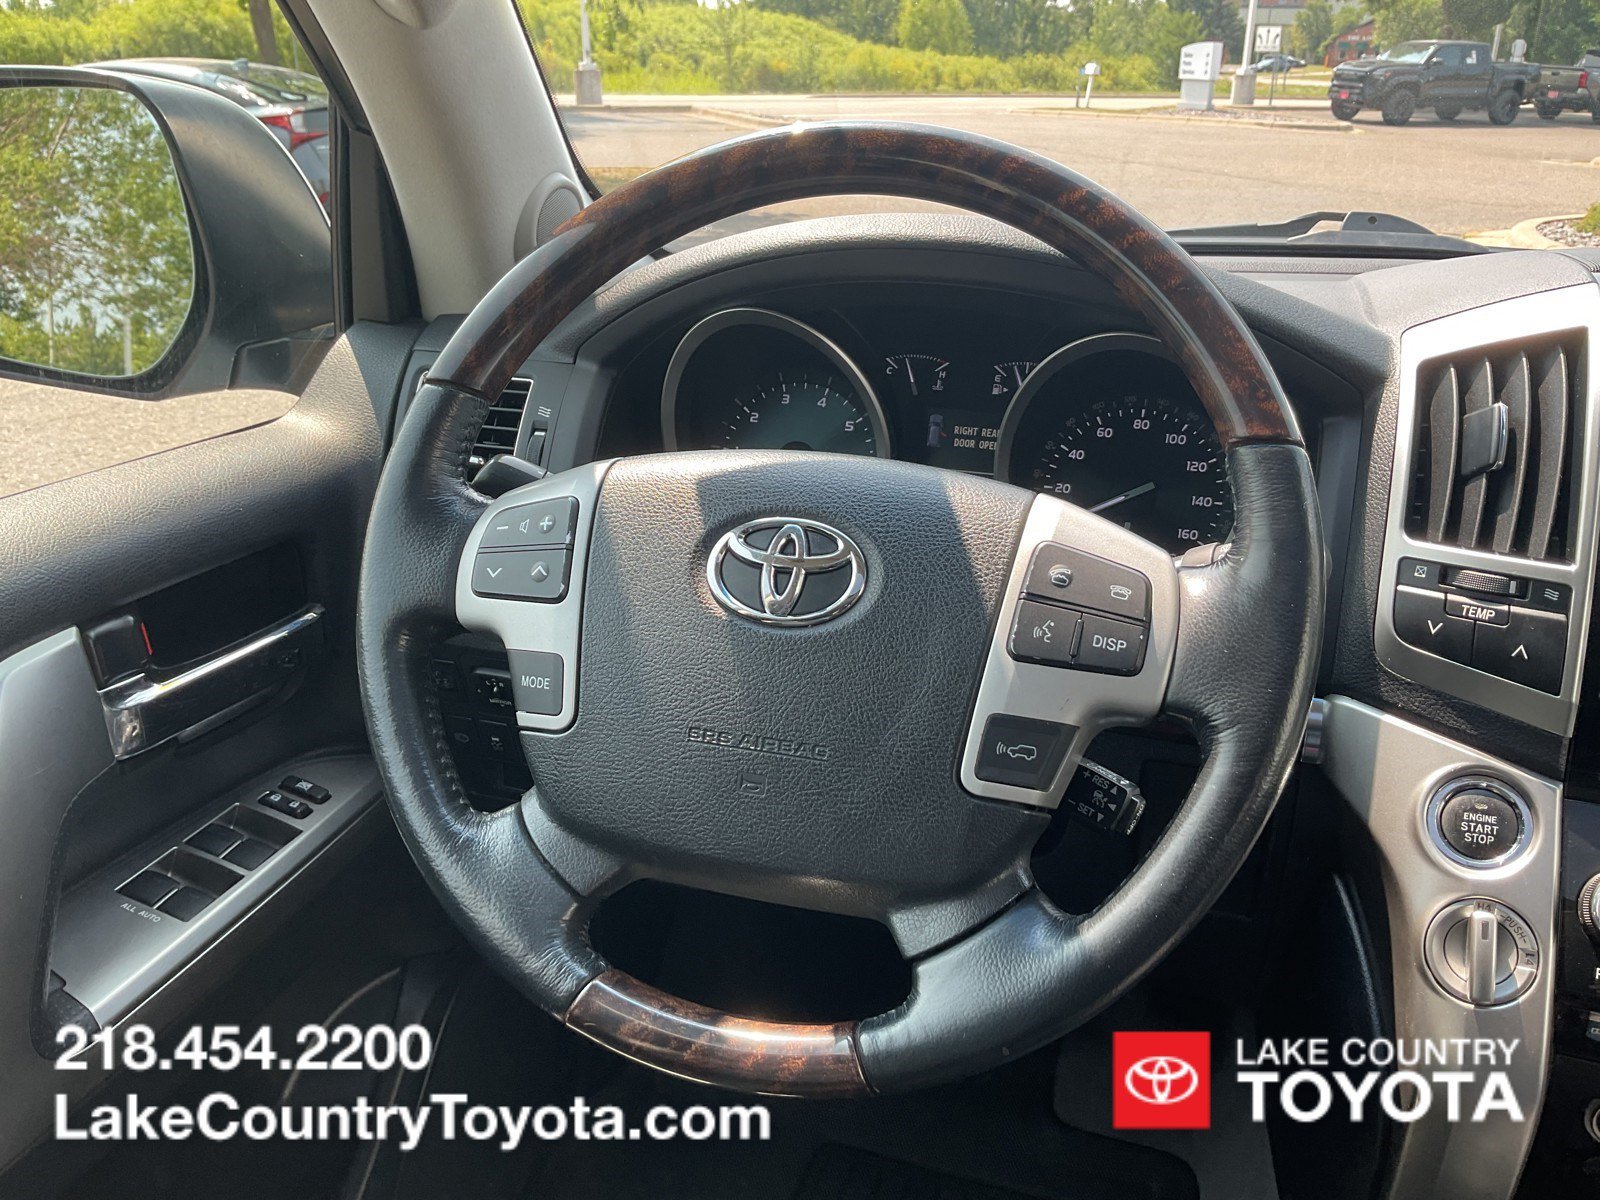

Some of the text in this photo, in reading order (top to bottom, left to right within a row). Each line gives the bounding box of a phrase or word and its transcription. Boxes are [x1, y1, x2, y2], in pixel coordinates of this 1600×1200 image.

[886, 366, 893, 375] C
[938, 371, 946, 379] H
[994, 374, 1001, 382] E
[781, 393, 790, 405] 3
[817, 397, 827, 408] 4
[750, 412, 759, 423] 2
[844, 421, 854, 432] 5
[1132, 419, 1150, 430] 80
[953, 425, 979, 437] RIGHT
[1096, 427, 1113, 438] 60
[953, 438, 975, 449] DOOR
[1165, 433, 1187, 445] 100
[1068, 449, 1085, 460] 40
[1186, 460, 1208, 473] 120
[1054, 483, 1071, 494] 20
[1191, 495, 1213, 508] 140
[1177, 528, 1199, 540] 160
[1461, 604, 1496, 621] TEMP
[1092, 634, 1127, 652] DISP
[521, 675, 550, 690] MODE
[687, 727, 830, 761] SRS AIRBAG
[1091, 774, 1110, 790] RES
[1077, 802, 1095, 817] SET
[1463, 812, 1498, 825] ENGINE
[1460, 822, 1499, 836] START
[1464, 833, 1495, 845] STOP
[120, 903, 162, 923] ALL AUTO
